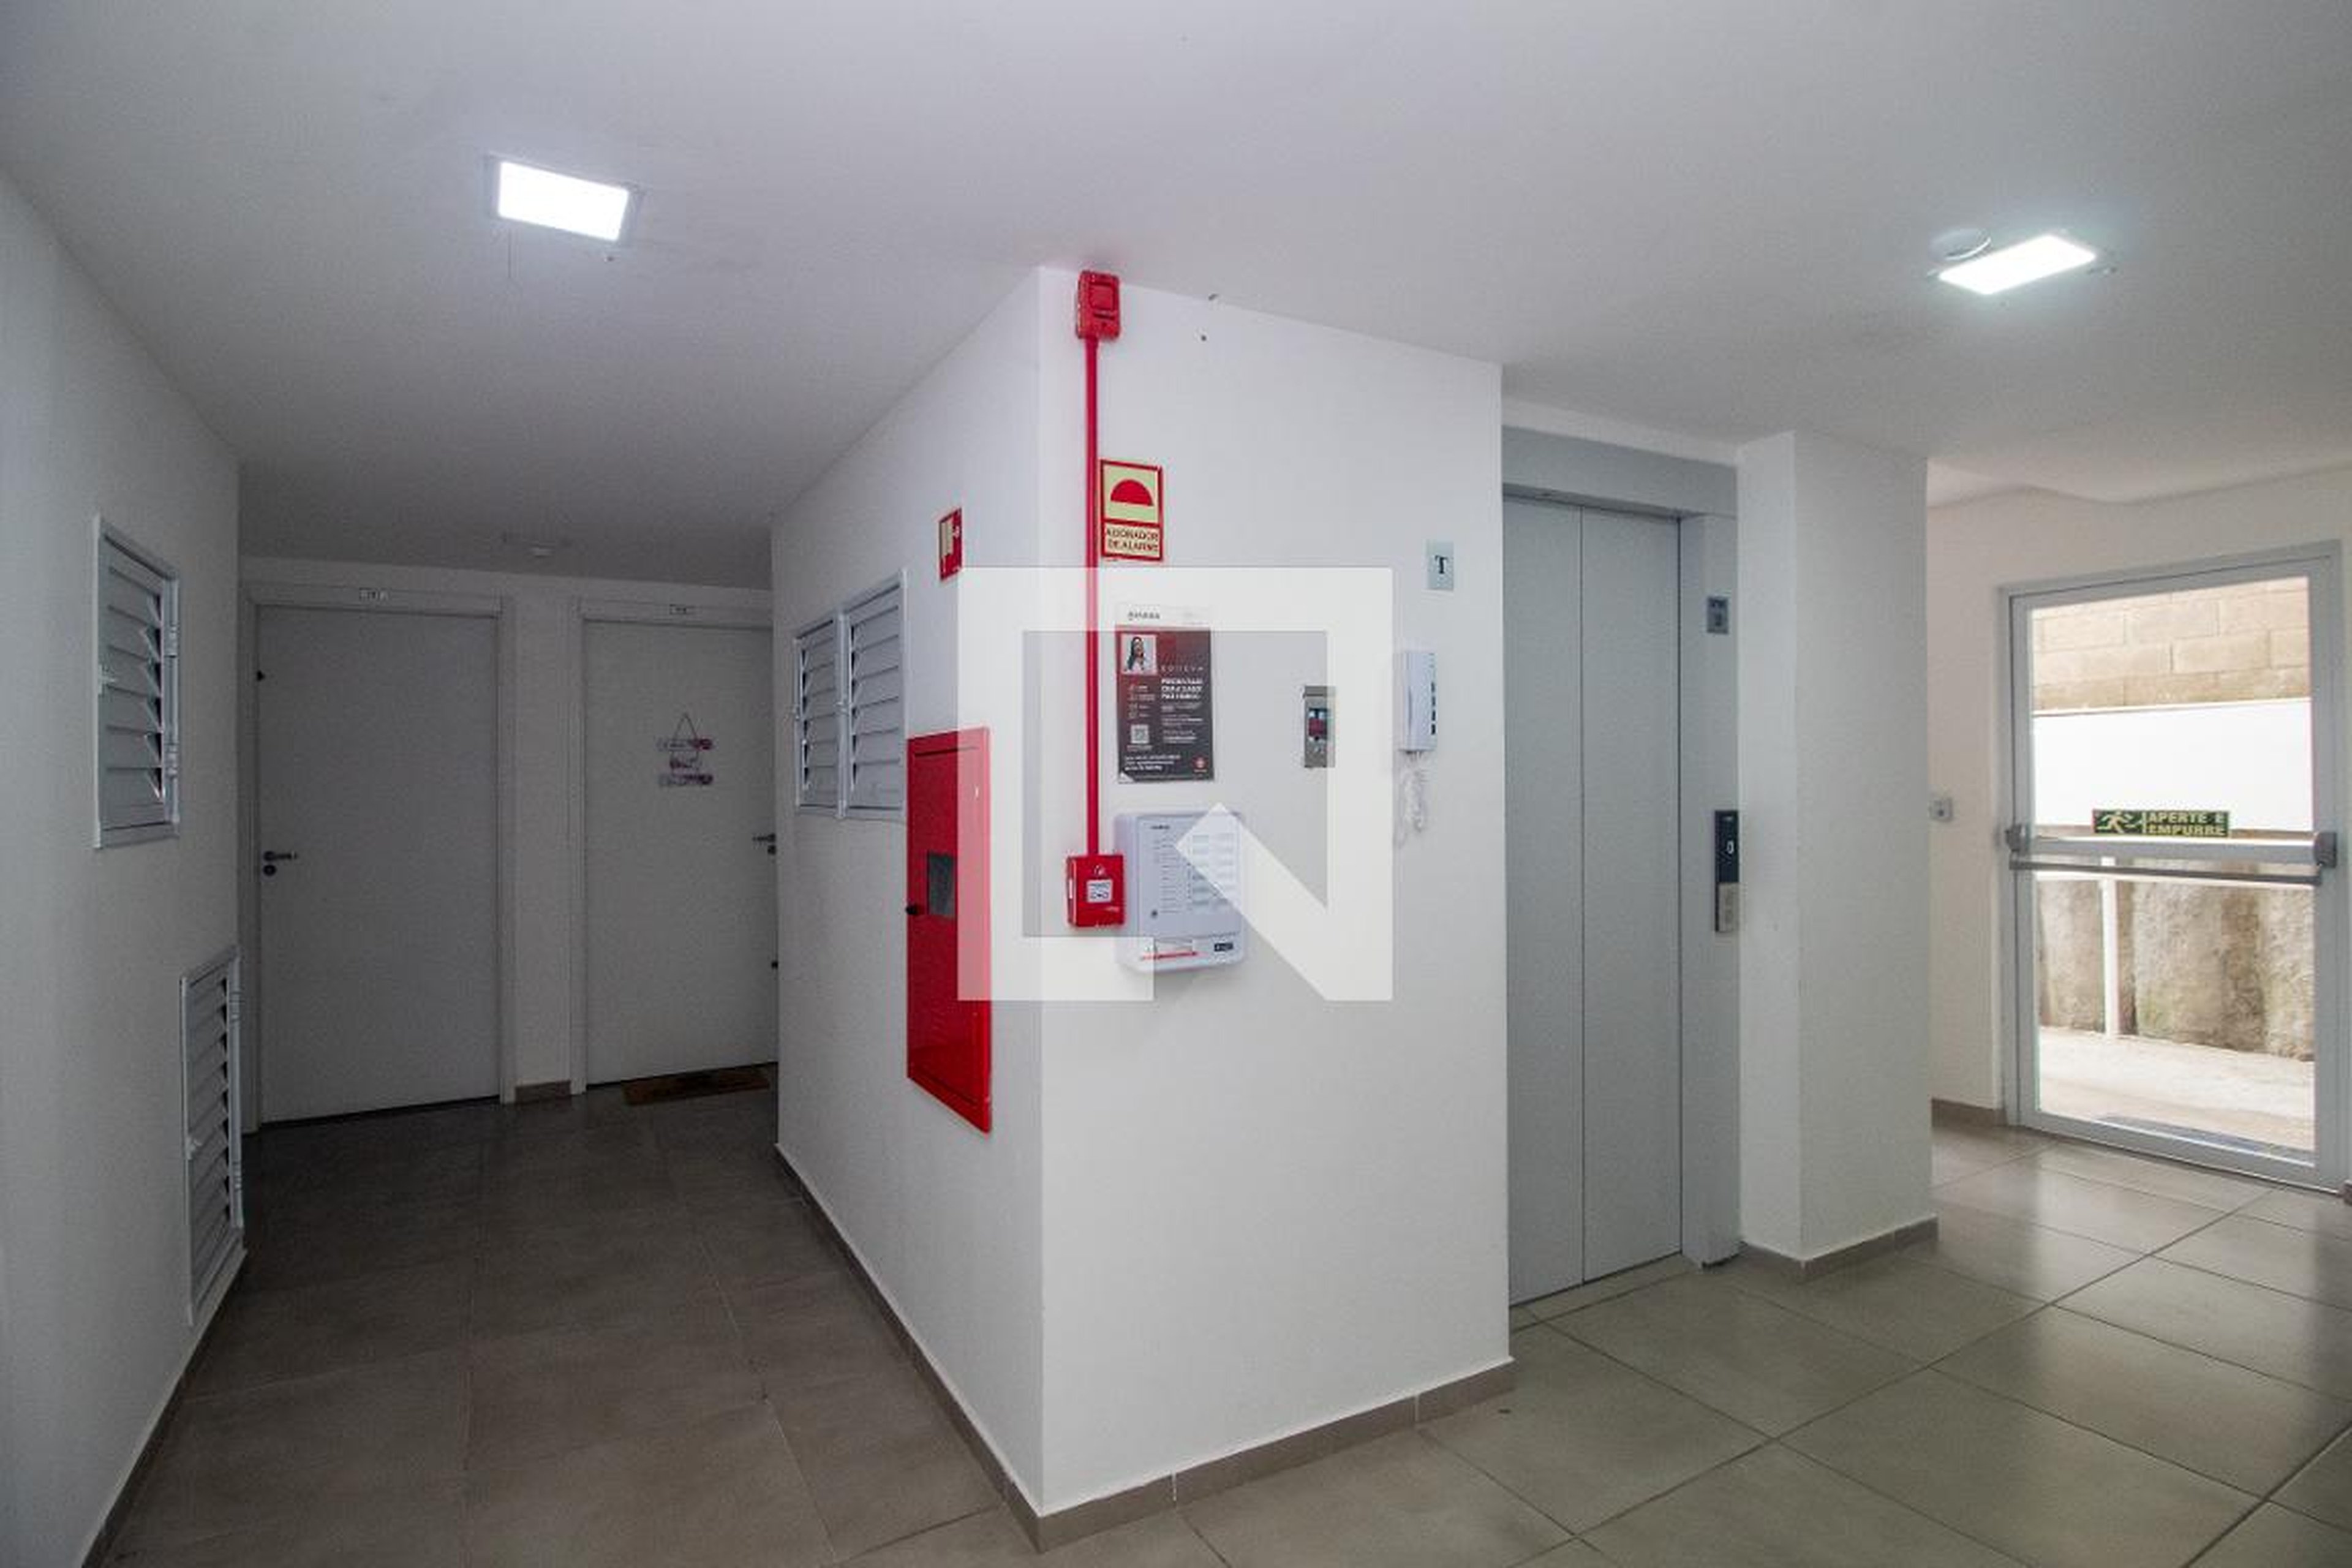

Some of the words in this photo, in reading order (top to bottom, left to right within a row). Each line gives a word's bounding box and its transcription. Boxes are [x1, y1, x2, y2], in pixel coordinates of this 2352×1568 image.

[1434, 554, 1448, 575] T
[2149, 812, 2208, 823] APERTE
[2215, 812, 2225, 824] E
[2149, 824, 2226, 836] EMPURRE
